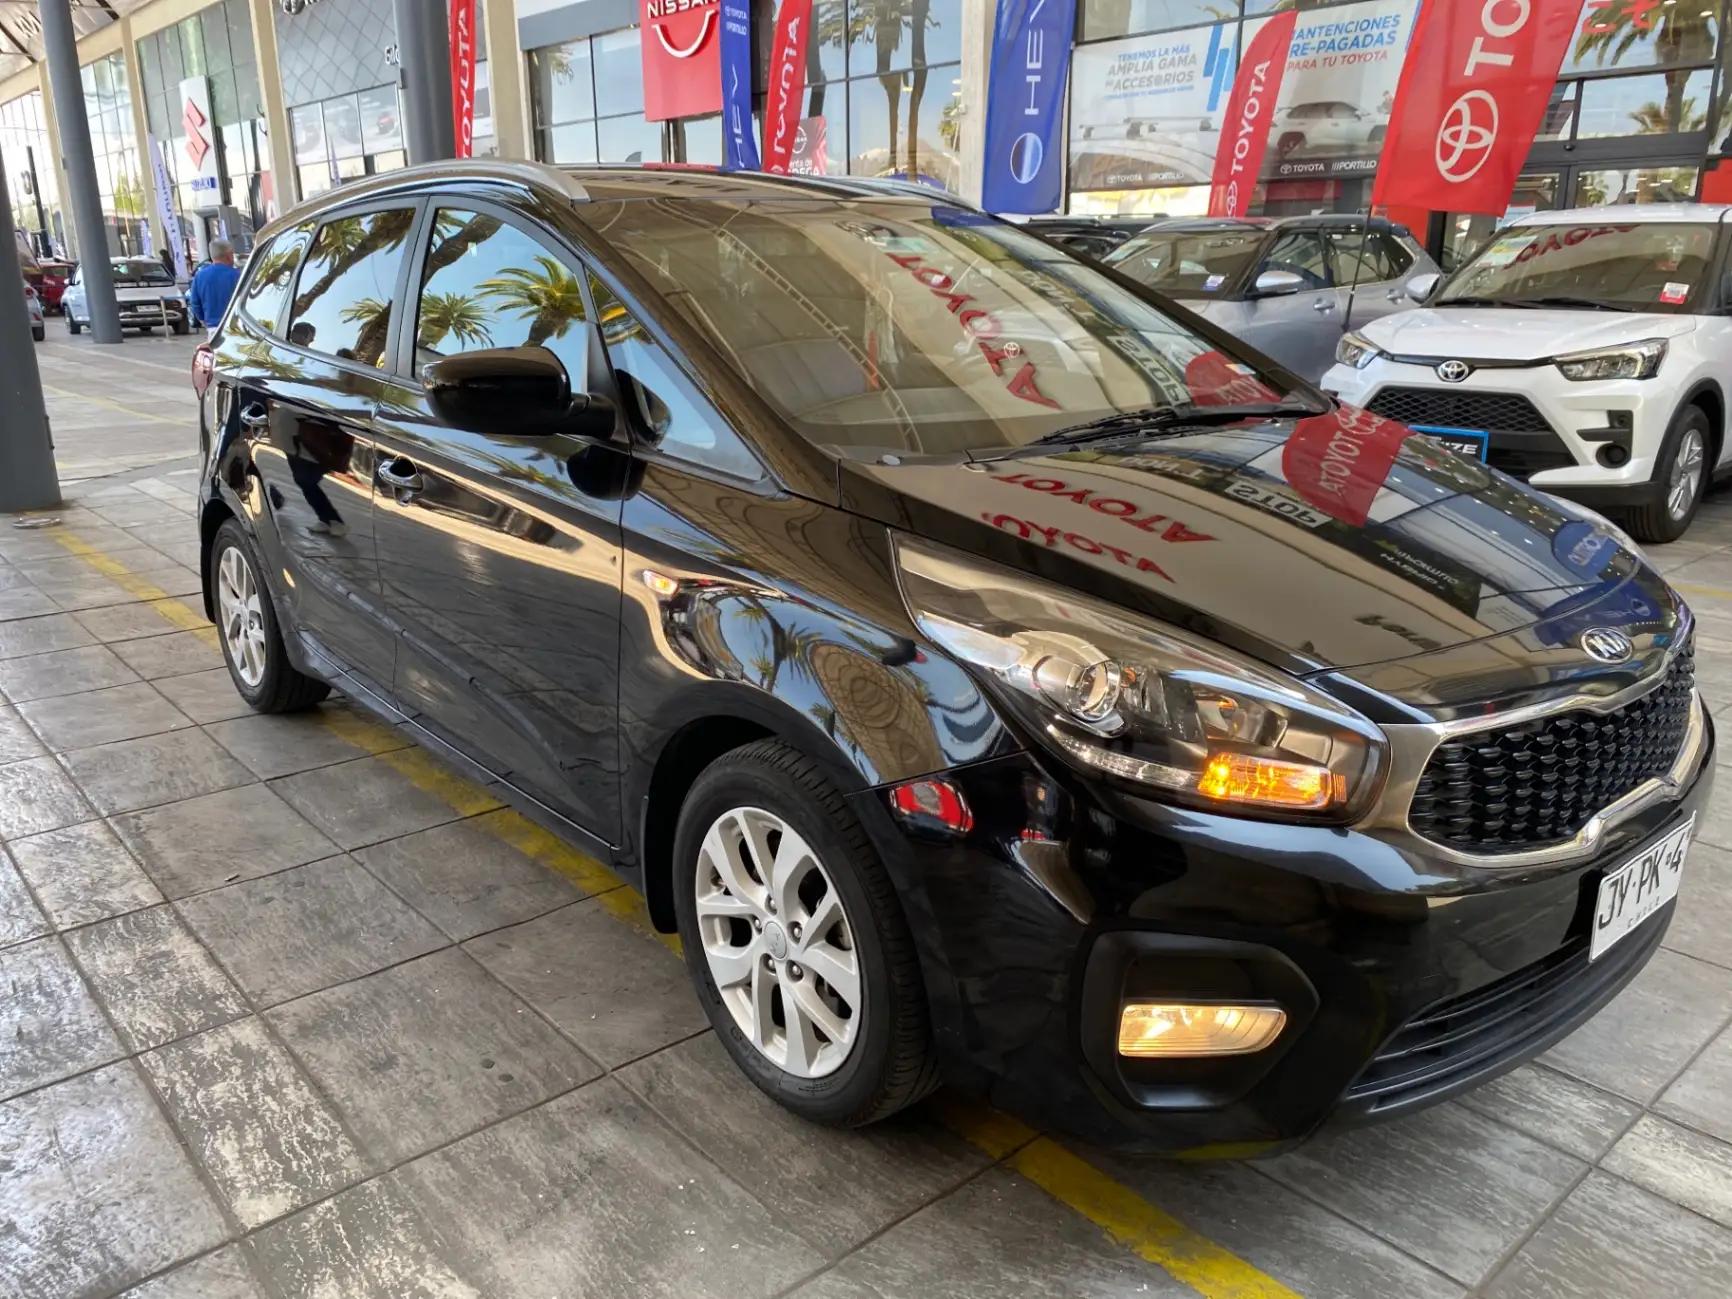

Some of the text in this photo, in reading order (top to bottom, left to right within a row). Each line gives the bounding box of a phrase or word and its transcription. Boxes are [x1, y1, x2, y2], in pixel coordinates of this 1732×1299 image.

[646, 0, 716, 19] NISSA
[1291, 14, 1401, 41] ANTENCIONES
[1159, 47, 1170, 57] LA
[1290, 30, 1397, 58] RE-PAGADAS
[1107, 53, 1198, 77] AMPLIA GAMA
[1287, 50, 1388, 71] PARA TU TOYOTA
[1230, 60, 1271, 176] TOYOTA
[1117, 174, 1143, 183] TOYOTA
[1293, 163, 1325, 173] TOYOTA
